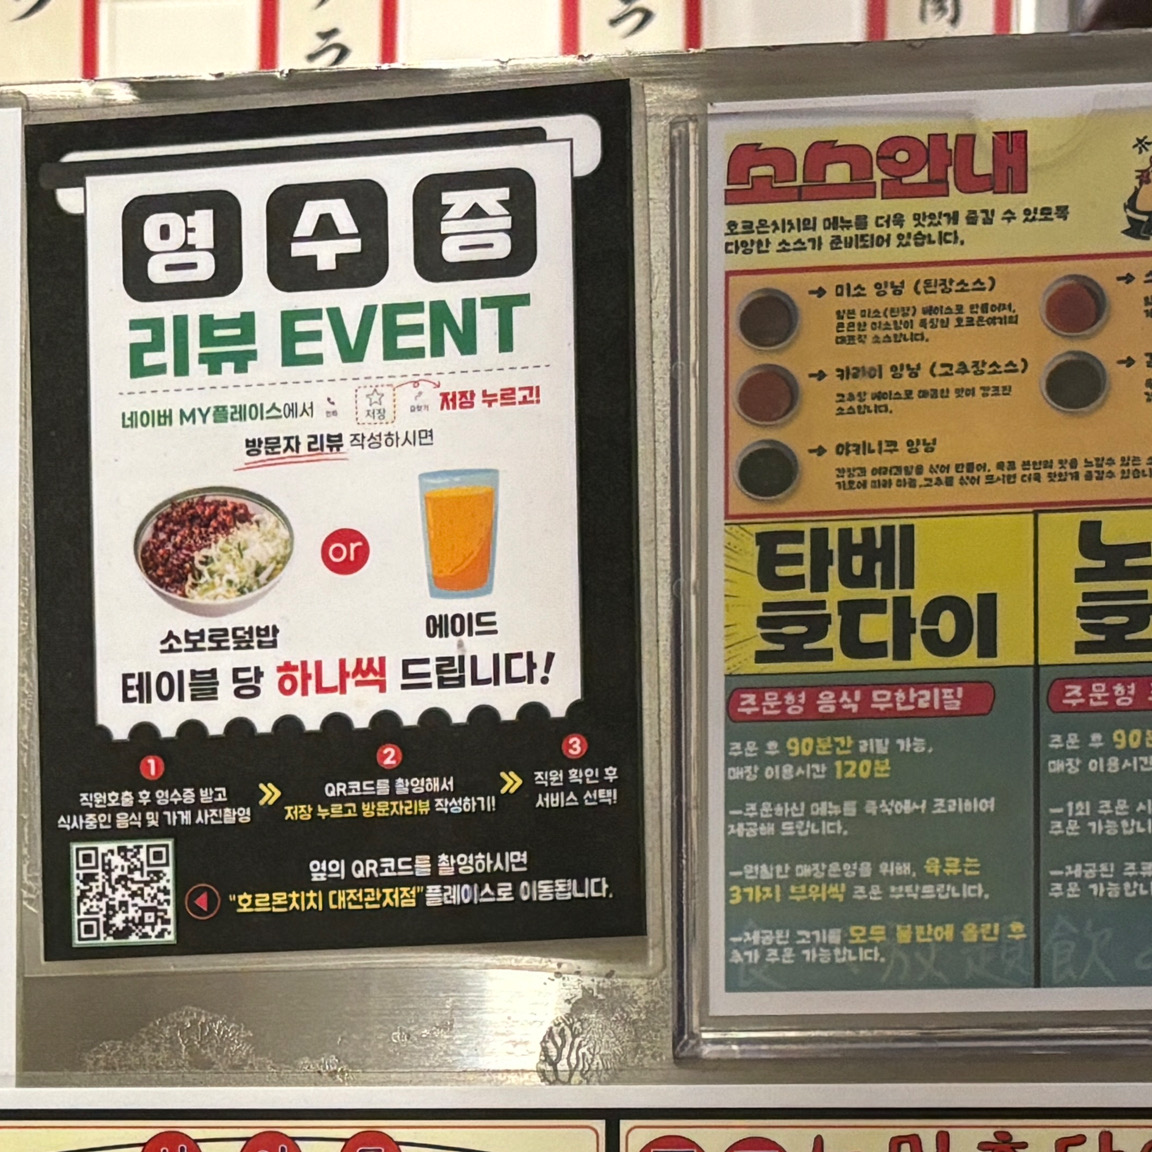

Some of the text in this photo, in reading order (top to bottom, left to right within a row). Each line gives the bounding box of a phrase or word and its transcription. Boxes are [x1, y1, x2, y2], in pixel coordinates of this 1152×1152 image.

[724, 130, 1028, 206] 소스안내
[142, 187, 512, 285] 영수증
[129, 293, 531, 380] 리뷰 EVENT
[439, 390, 476, 412] 저장
[481, 384, 541, 410] 누르고!
[121, 408, 173, 429] 네이버
[180, 401, 315, 426] MY플레이스에서
[245, 429, 434, 456] 방문자 리뷰 작성하시면
[328, 539, 362, 564] or
[755, 523, 915, 593] 타베
[159, 623, 280, 654] 소보로덮밥
[425, 612, 498, 638] 에이드
[754, 593, 998, 664] 호다이
[121, 651, 556, 704] 테이블 당 하나씩 드립니다!
[737, 686, 964, 715] 주문형 음식 무한리필
[325, 775, 455, 798] QR코드를 촬영해서
[535, 788, 618, 809] 서비스 선택!
[361, 794, 496, 817] 방문자리뷰 작성하기!
[309, 851, 528, 881] 옆의 QR코드를 촬영하시면
[519, 878, 614, 902] 이동됩니다.
